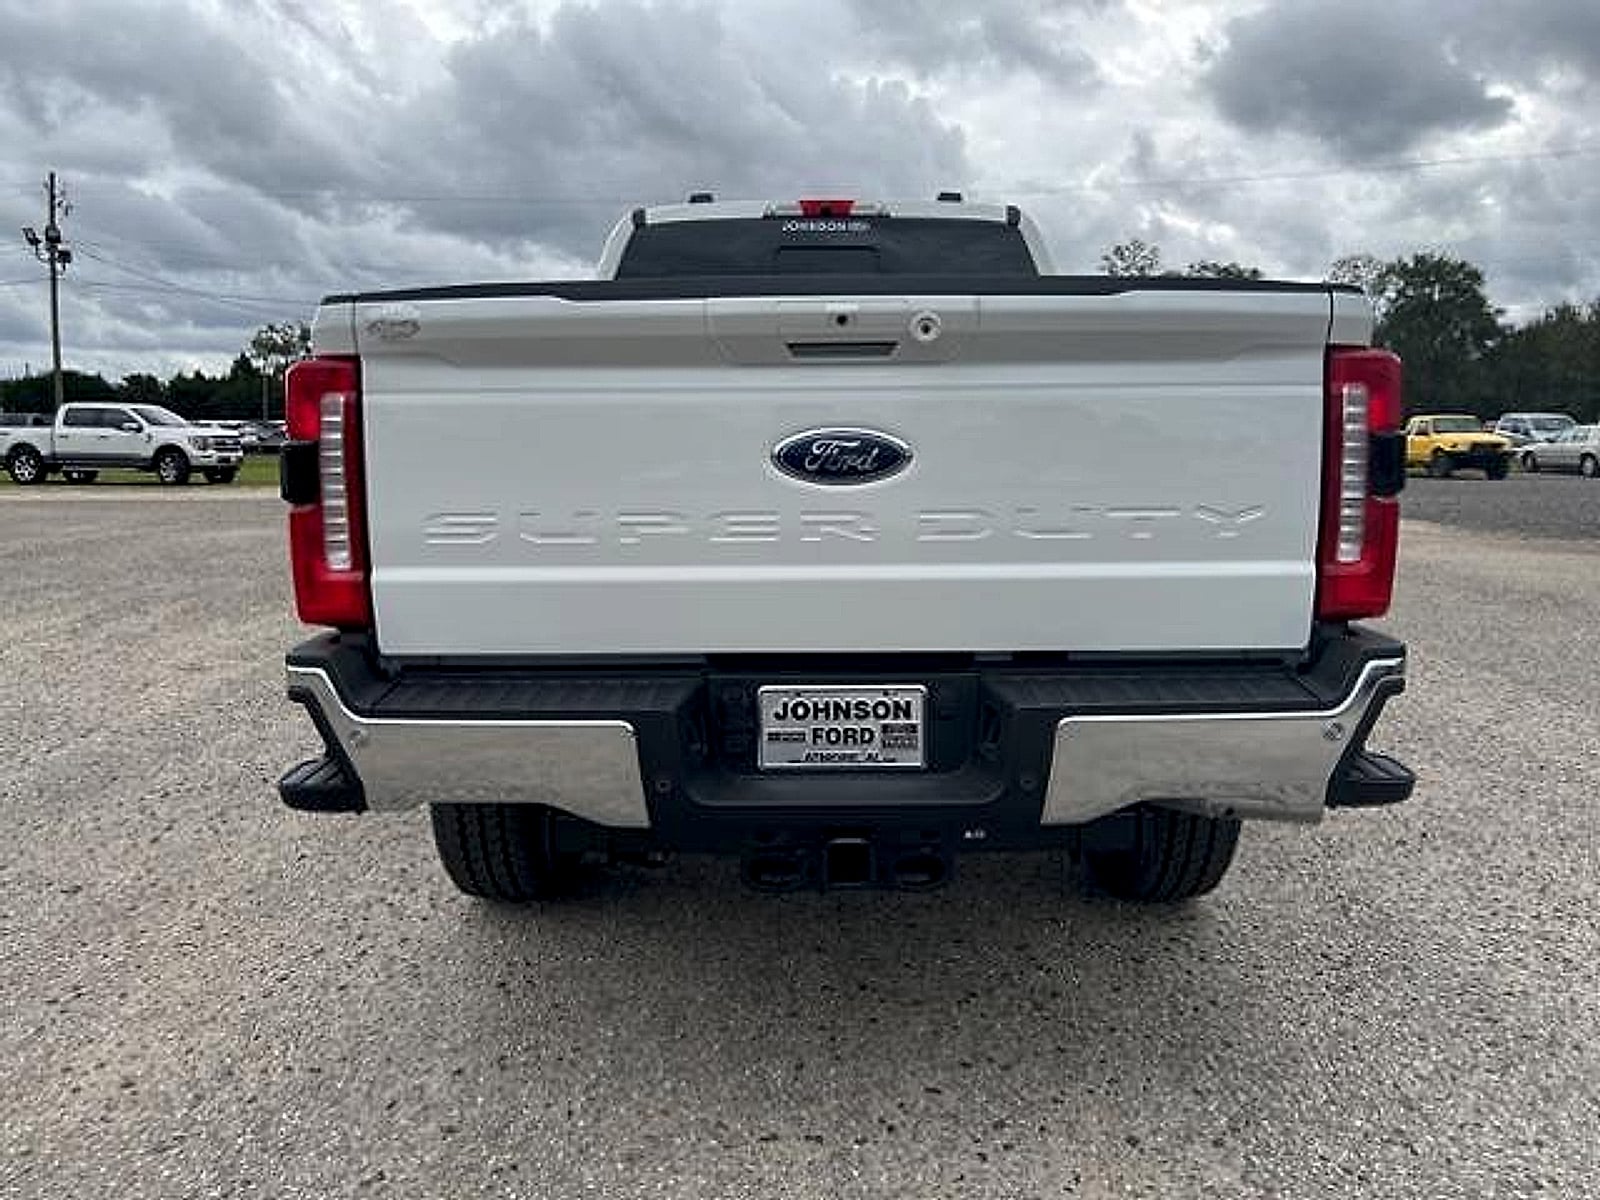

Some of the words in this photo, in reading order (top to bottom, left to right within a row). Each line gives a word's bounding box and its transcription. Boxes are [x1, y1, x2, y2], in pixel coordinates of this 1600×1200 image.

[804, 439, 880, 471] Ford
[421, 508, 878, 545] SUPER
[916, 504, 1267, 542] DUTY
[773, 699, 912, 721] JOHNSON
[811, 726, 875, 745] FORD
